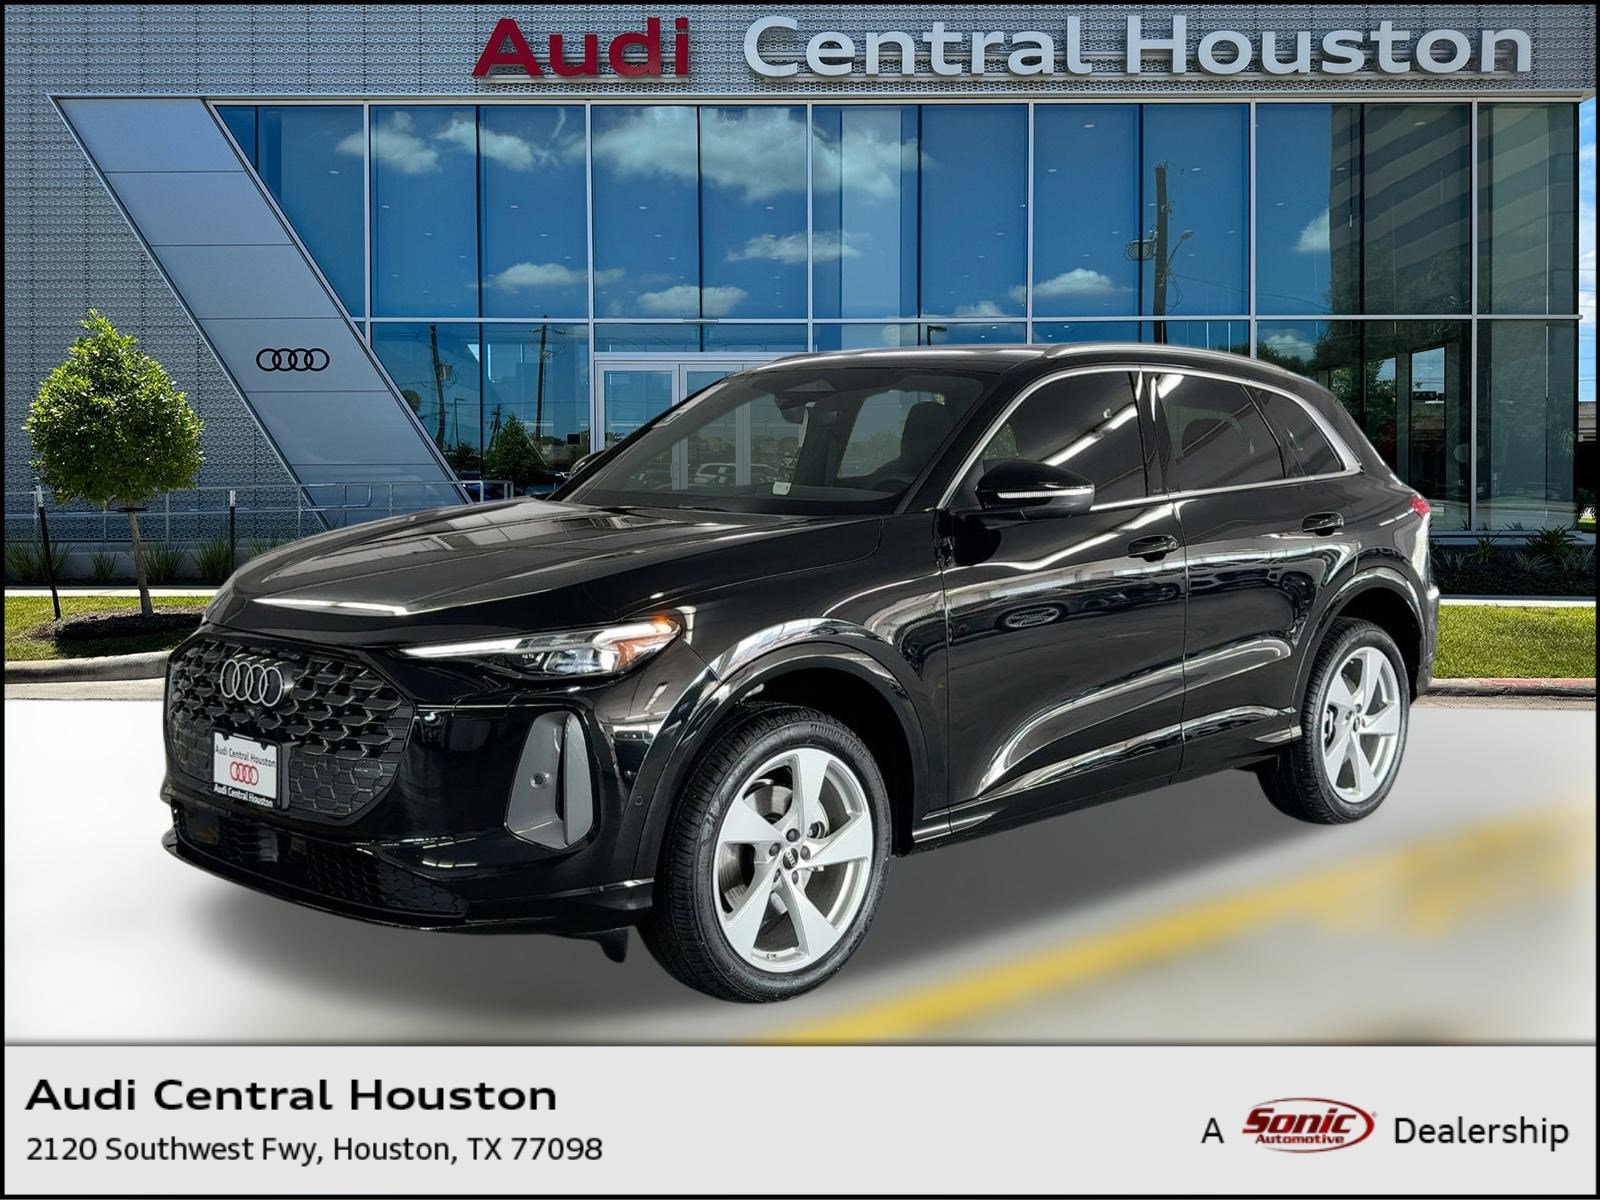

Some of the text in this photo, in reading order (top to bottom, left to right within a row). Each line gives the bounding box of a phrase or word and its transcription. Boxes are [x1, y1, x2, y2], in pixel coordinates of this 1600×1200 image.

[471, 14, 1532, 78] Audi Central Houston
[215, 744, 276, 768] Audi Central Houston
[214, 783, 274, 808] Audi Central Houston
